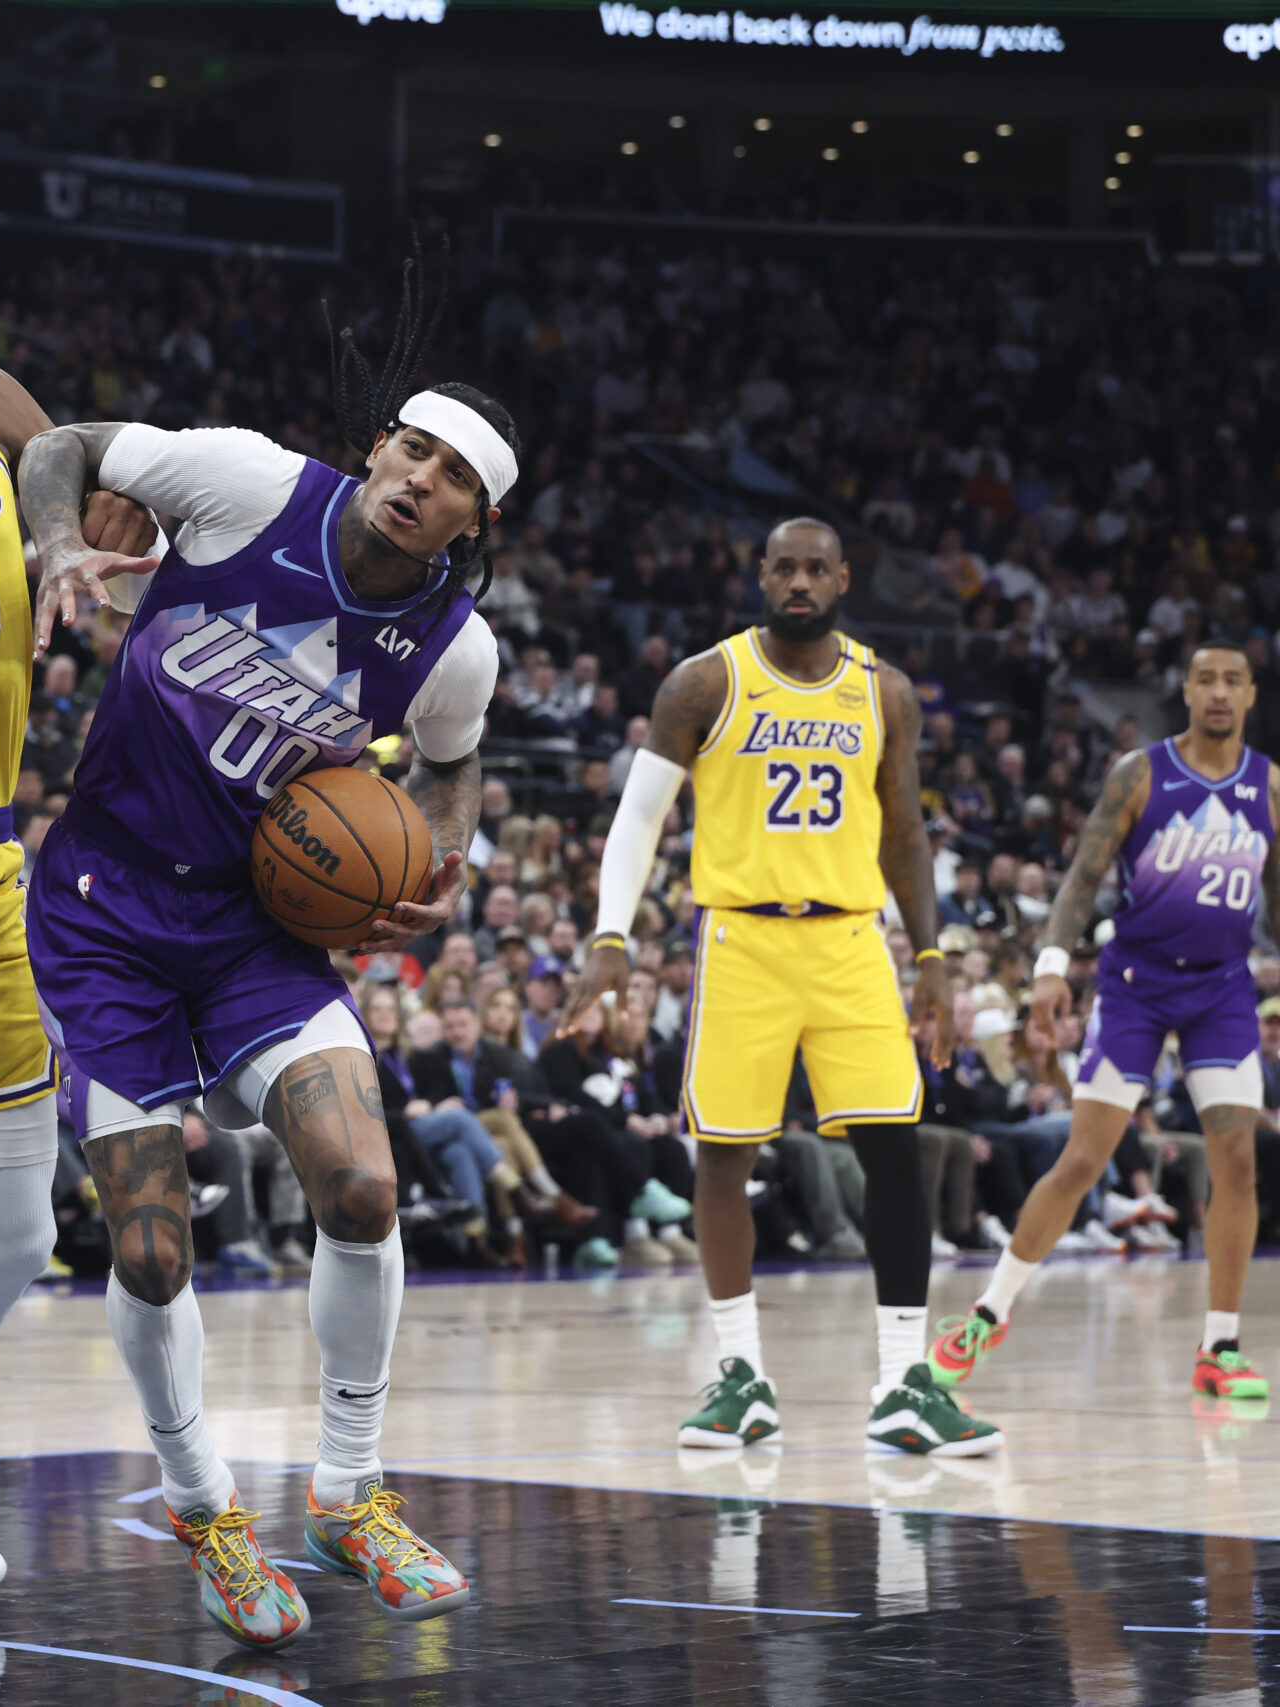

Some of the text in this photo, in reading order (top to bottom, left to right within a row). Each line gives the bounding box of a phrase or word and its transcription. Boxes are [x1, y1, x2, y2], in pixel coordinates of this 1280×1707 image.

[599, 1, 654, 37] We
[656, 6, 730, 42] dont
[733, 10, 811, 46] back
[814, 14, 906, 48] down
[902, 15, 982, 56] from
[160, 612, 371, 743] UTAH
[209, 707, 319, 800] 00
[735, 710, 863, 756] LAKERS
[765, 760, 844, 834] 23
[266, 788, 342, 878] Wilson
[1154, 824, 1256, 874] UTAH
[1196, 863, 1252, 911] 20
